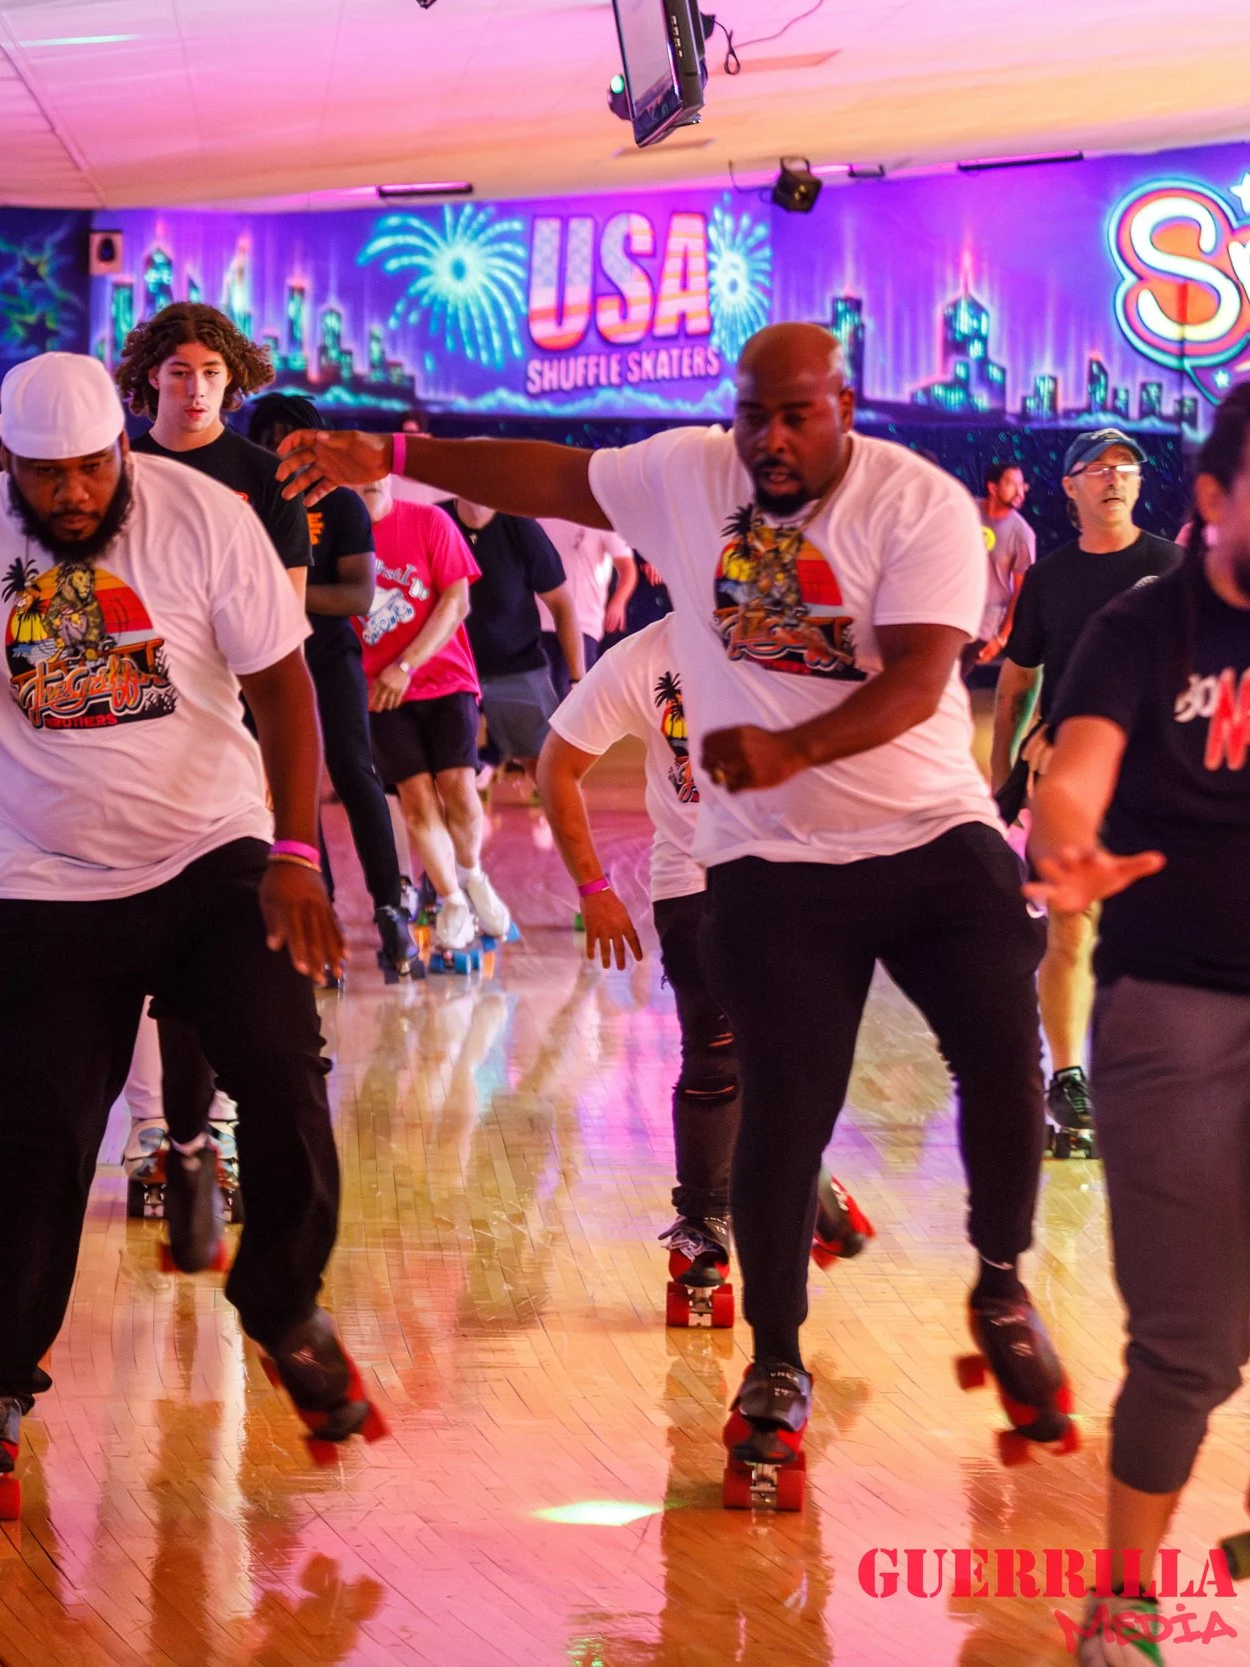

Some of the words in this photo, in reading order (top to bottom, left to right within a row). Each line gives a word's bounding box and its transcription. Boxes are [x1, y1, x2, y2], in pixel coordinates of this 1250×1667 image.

[528, 211, 712, 350] USA
[526, 354, 622, 395] SHUFFLE
[626, 345, 721, 384] SKATERS
